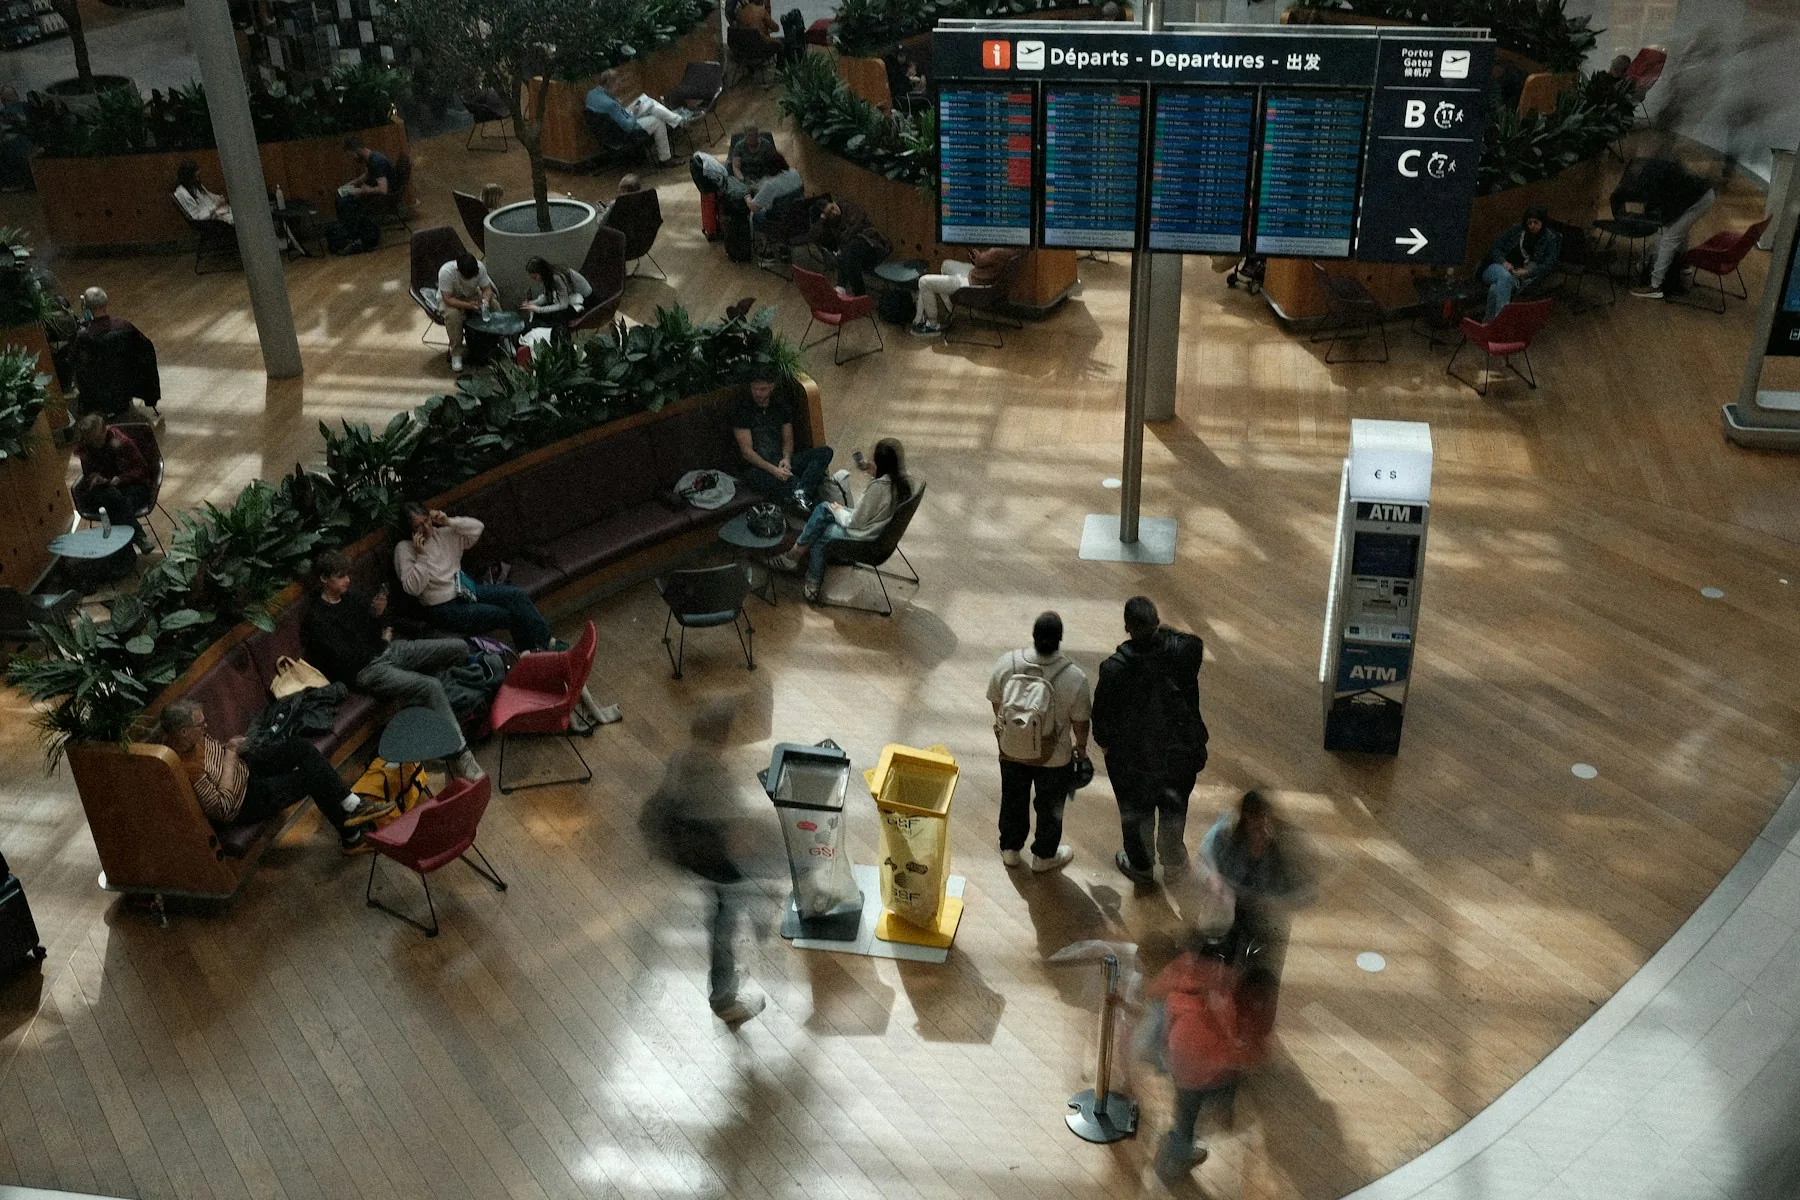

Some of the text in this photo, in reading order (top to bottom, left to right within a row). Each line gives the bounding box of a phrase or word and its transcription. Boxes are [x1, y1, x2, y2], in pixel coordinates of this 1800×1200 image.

[1050, 47, 1129, 69] Départs
[1150, 49, 1265, 71] Departures
[1286, 53, 1321, 71] 出发
[1401, 48, 1434, 58] Portes
[1403, 58, 1433, 67] Gates
[1404, 99, 1453, 128] B 11
[1397, 149, 1445, 178] C 7
[1368, 503, 1411, 522] ATM
[1349, 665, 1397, 682] ATM
